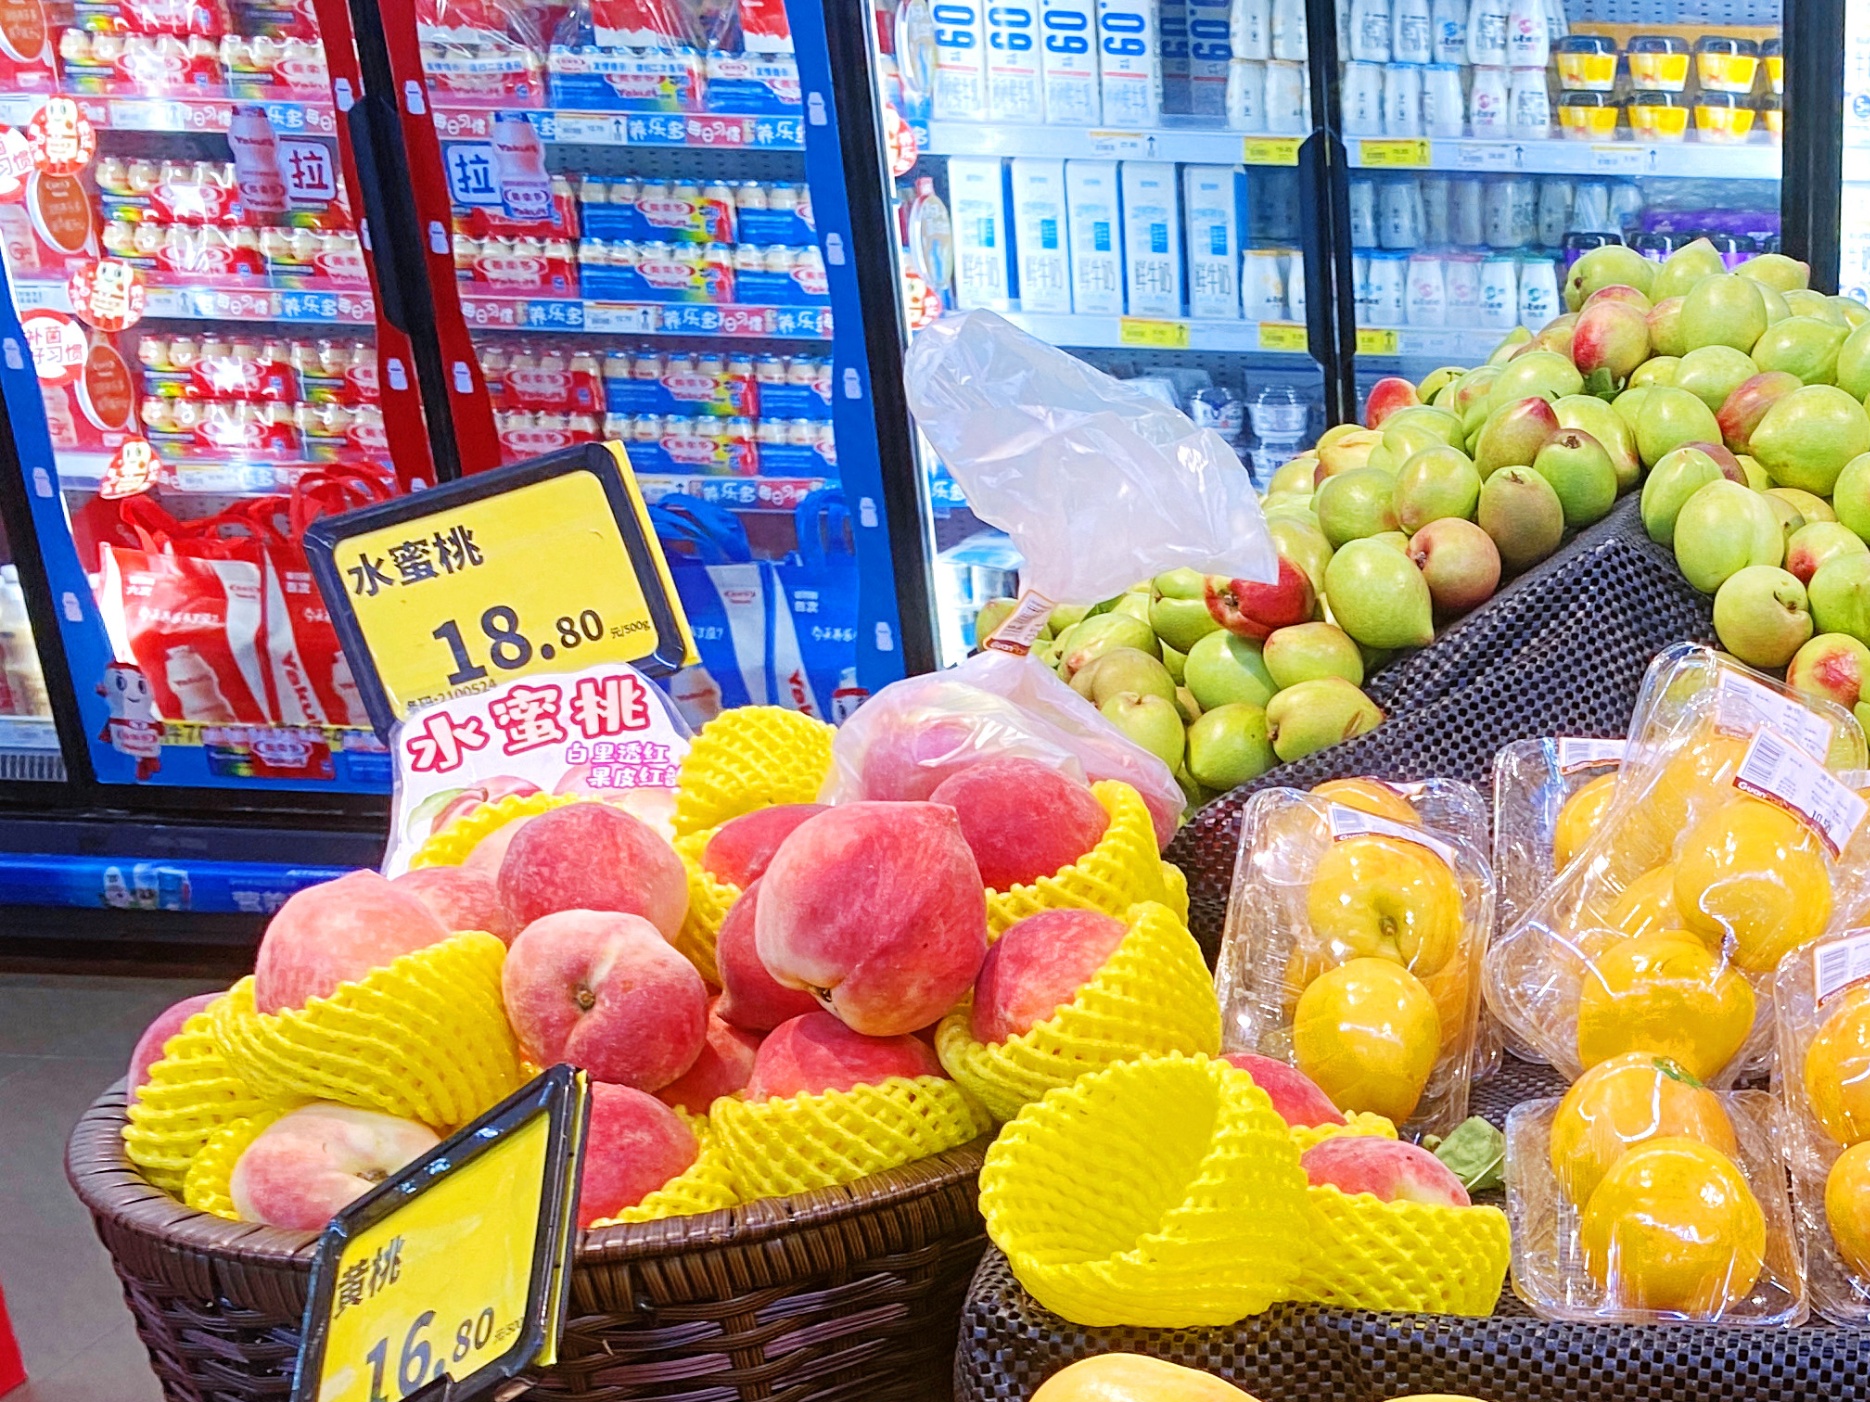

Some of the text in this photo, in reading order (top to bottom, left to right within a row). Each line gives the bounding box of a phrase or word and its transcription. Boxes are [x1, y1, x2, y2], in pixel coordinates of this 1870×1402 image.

[629, 117, 686, 140] 养乐多
[289, 149, 330, 192] 拉
[454, 153, 496, 195] 拉
[1134, 257, 1173, 294] 鲜牛奶
[1195, 262, 1231, 297] 鲜牛奶
[284, 294, 338, 317] 养乐多
[529, 303, 584, 327] 养乐多
[663, 307, 719, 331] 养乐多
[347, 525, 485, 597] 水蜜桃
[432, 605, 651, 684] 18.80 元/500g
[407, 674, 651, 774] 水蜜桃
[565, 742, 671, 765] 白里透红
[334, 1235, 406, 1320] 黄桃
